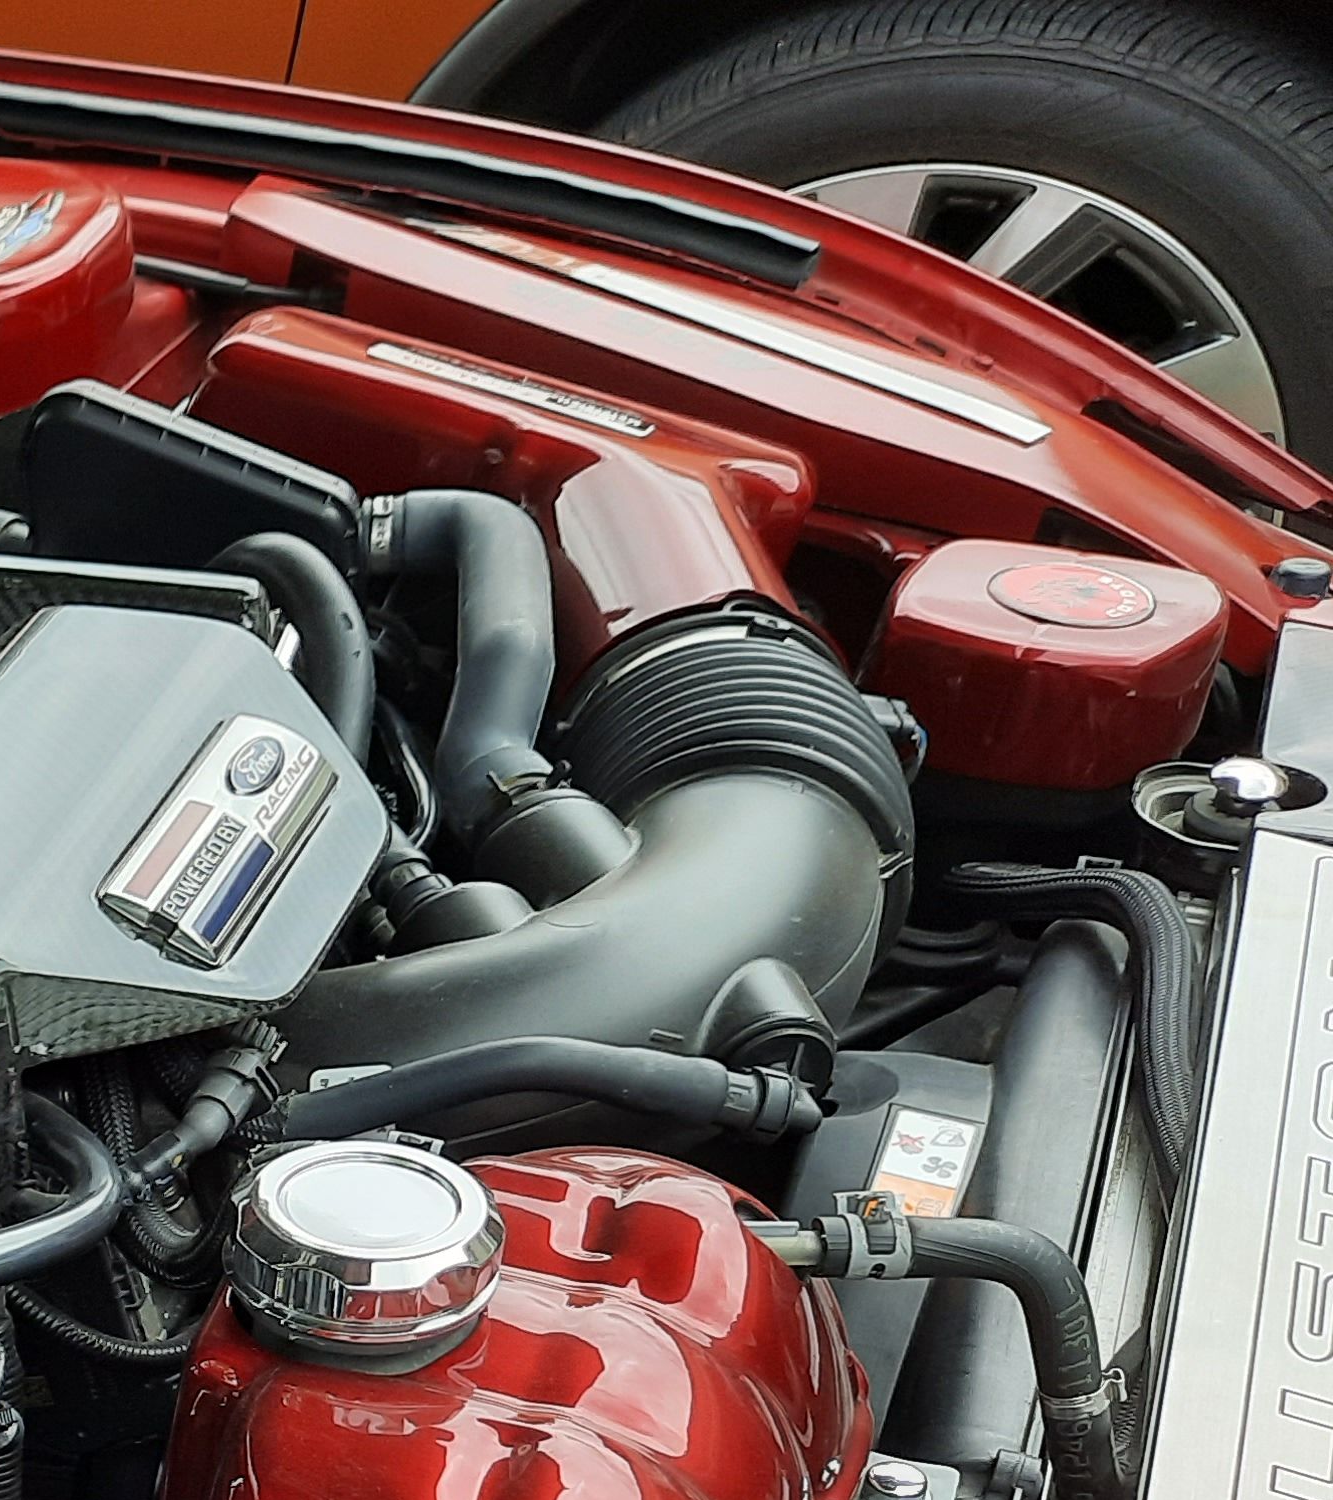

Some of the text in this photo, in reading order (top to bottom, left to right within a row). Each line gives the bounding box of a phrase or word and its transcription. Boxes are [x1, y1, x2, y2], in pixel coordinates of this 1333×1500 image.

[237, 746, 280, 784] Ford
[252, 744, 317, 832] RACING
[160, 814, 242, 920] POWERED BY
